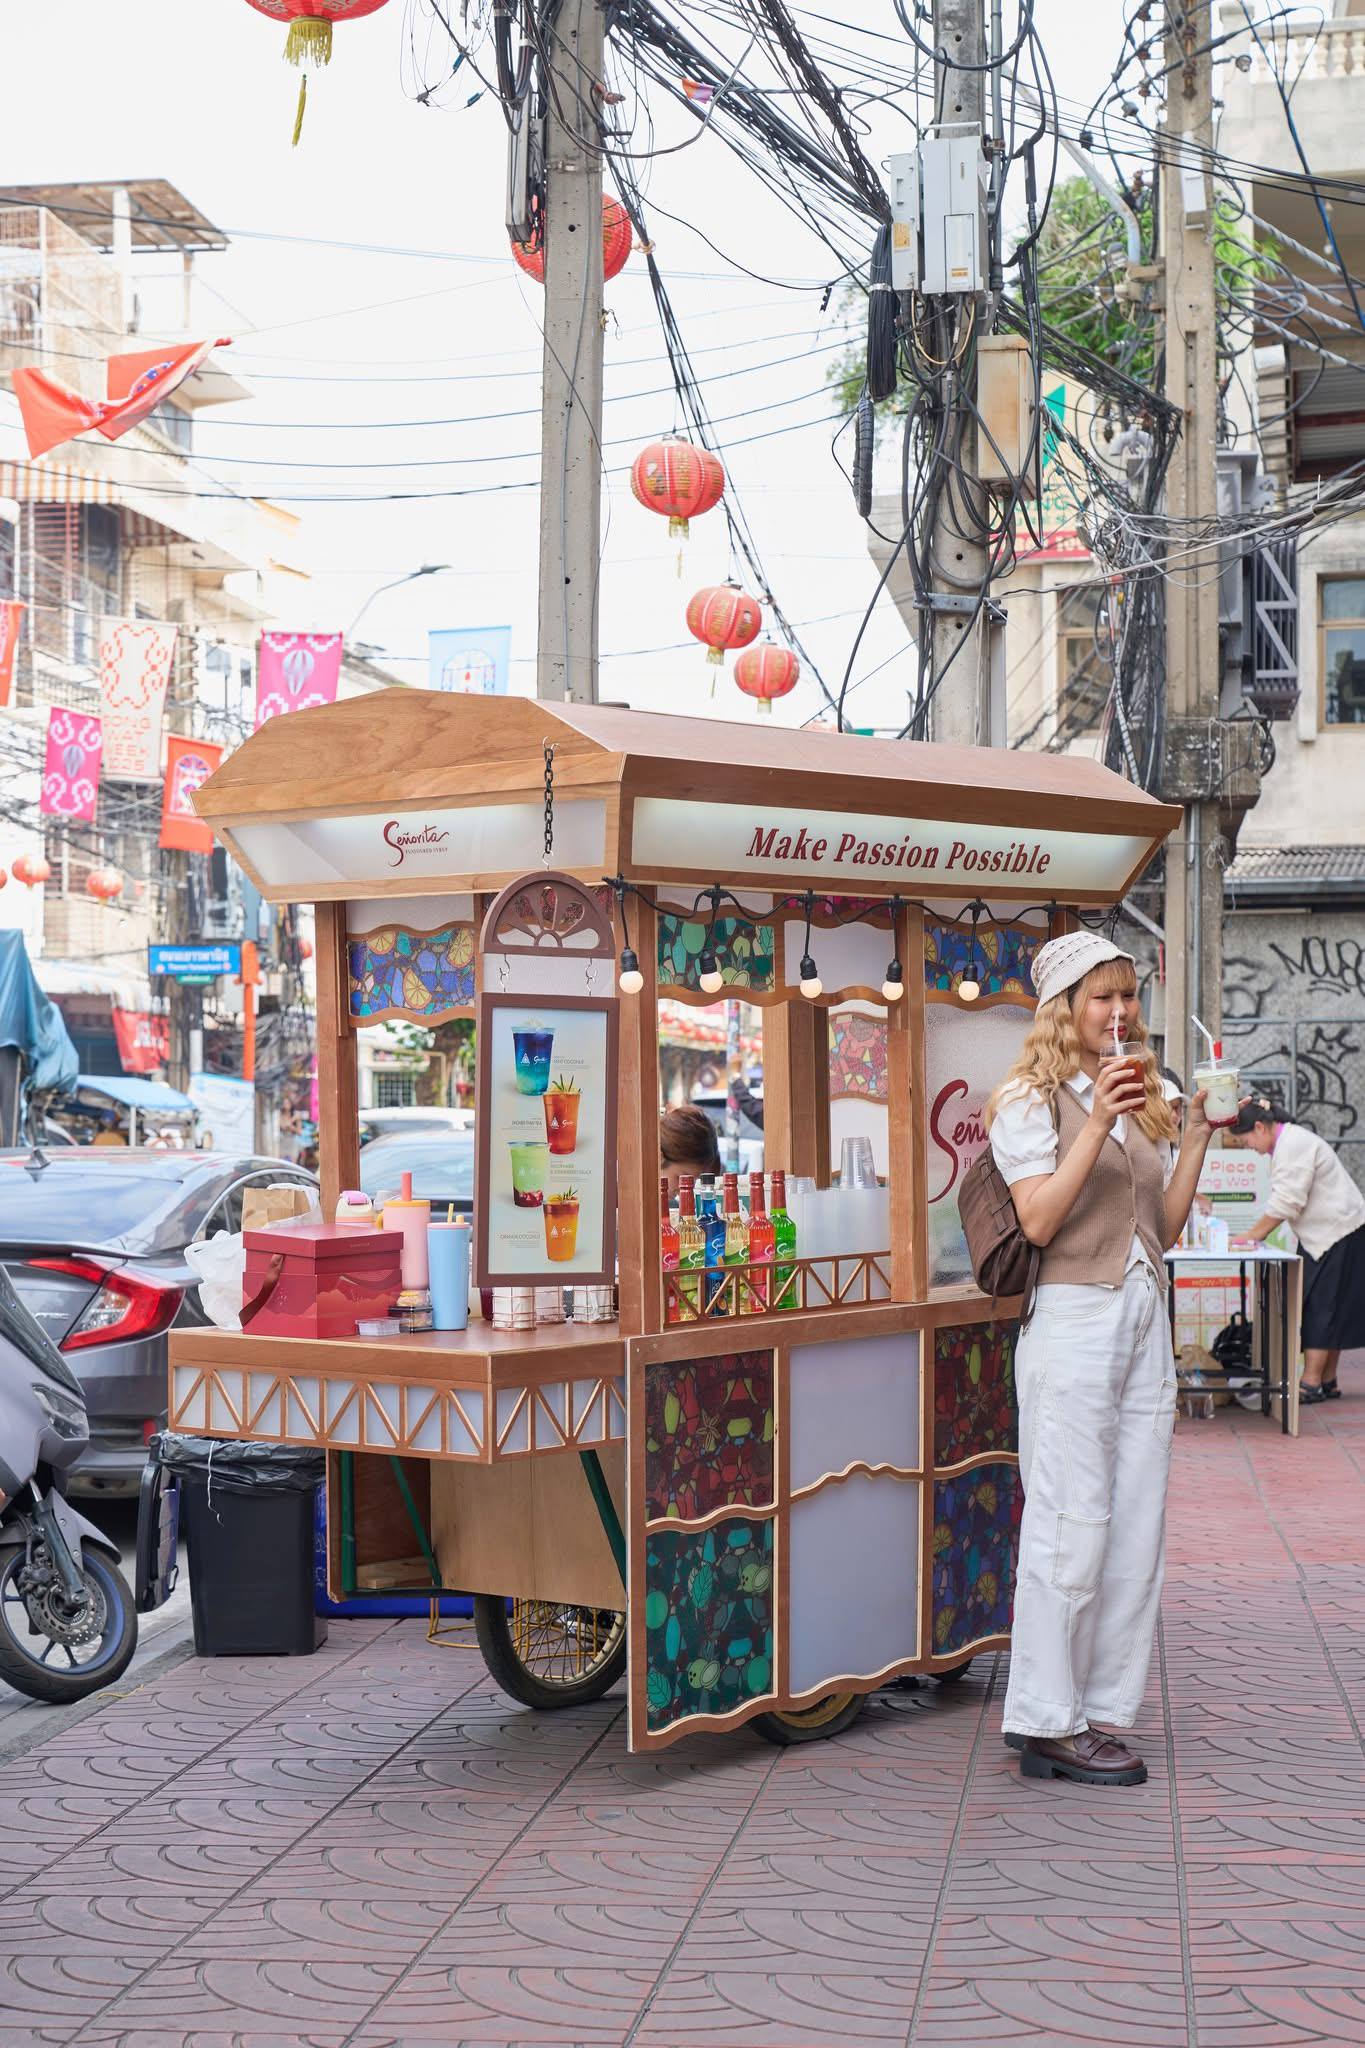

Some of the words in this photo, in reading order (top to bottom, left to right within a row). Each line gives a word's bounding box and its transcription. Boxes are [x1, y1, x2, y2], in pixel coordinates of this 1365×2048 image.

[383, 820, 450, 867] Señorita
[746, 827, 828, 861] Make
[833, 833, 940, 868] Passion
[944, 841, 1052, 874] Possible
[1210, 1161, 1256, 1173] Piece
[1227, 1176, 1256, 1187] Wat
